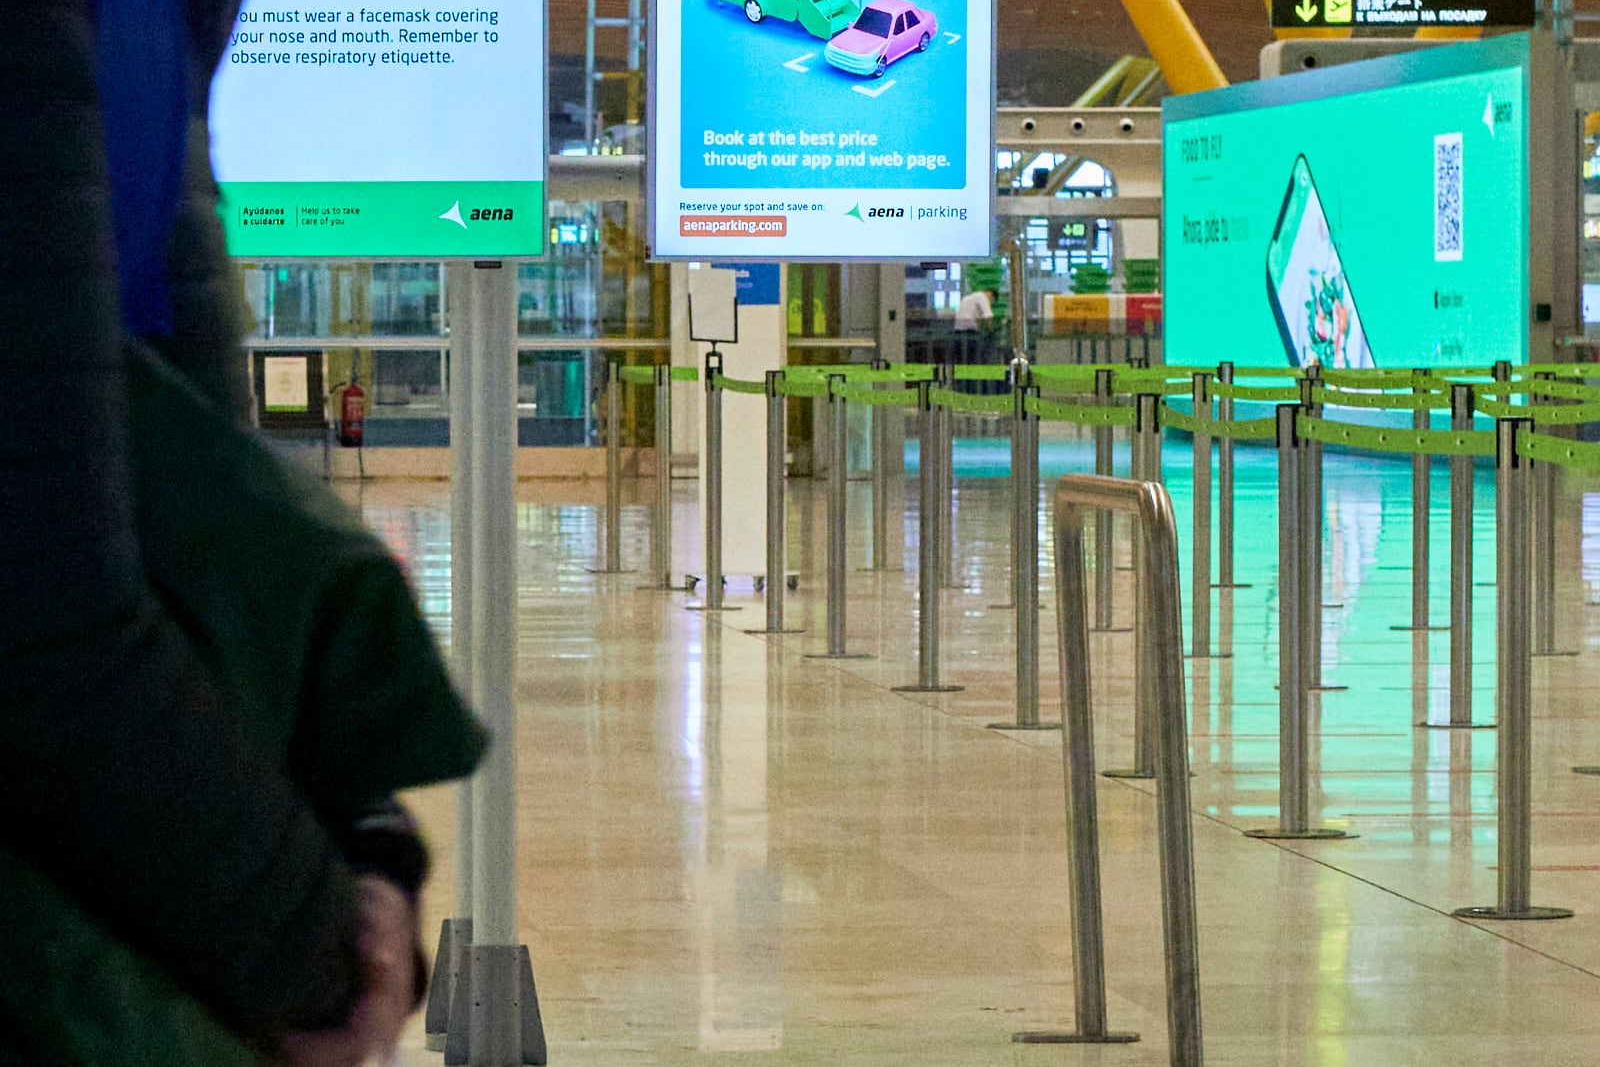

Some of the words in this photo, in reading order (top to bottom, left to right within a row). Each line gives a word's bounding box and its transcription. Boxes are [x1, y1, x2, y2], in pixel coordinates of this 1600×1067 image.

[240, 11, 258, 22] ou
[263, 10, 300, 22] must
[305, 11, 342, 22] wear
[347, 11, 355, 22] a
[360, 9, 430, 22] facemask
[435, 9, 498, 25] covering
[232, 31, 263, 46] your
[269, 31, 304, 43] nose
[310, 29, 337, 43] and
[342, 29, 394, 43] mouth.
[399, 29, 478, 43] Remember
[483, 31, 499, 43] to
[232, 51, 290, 64] observe
[295, 50, 376, 66] respiratory
[381, 51, 455, 66] etiquette.
[704, 131, 743, 145] Book
[748, 132, 764, 145] at
[769, 131, 795, 145] the
[800, 131, 834, 145] best
[839, 131, 878, 148] price
[703, 151, 767, 169] through
[771, 155, 798, 166] our
[802, 155, 831, 169] app
[836, 152, 864, 166] and
[869, 152, 901, 166] web
[907, 155, 951, 169] page.
[243, 207, 284, 216] Ayúdanos
[470, 206, 513, 221] aena
[679, 202, 716, 211] Reserve
[720, 203, 742, 213] your
[744, 202, 764, 213] spot
[767, 202, 784, 211] and
[787, 203, 808, 211] save
[868, 206, 904, 217] aena
[918, 206, 967, 220] parking
[320, 217, 328, 225] of
[684, 219, 782, 233] aenaparking.com
